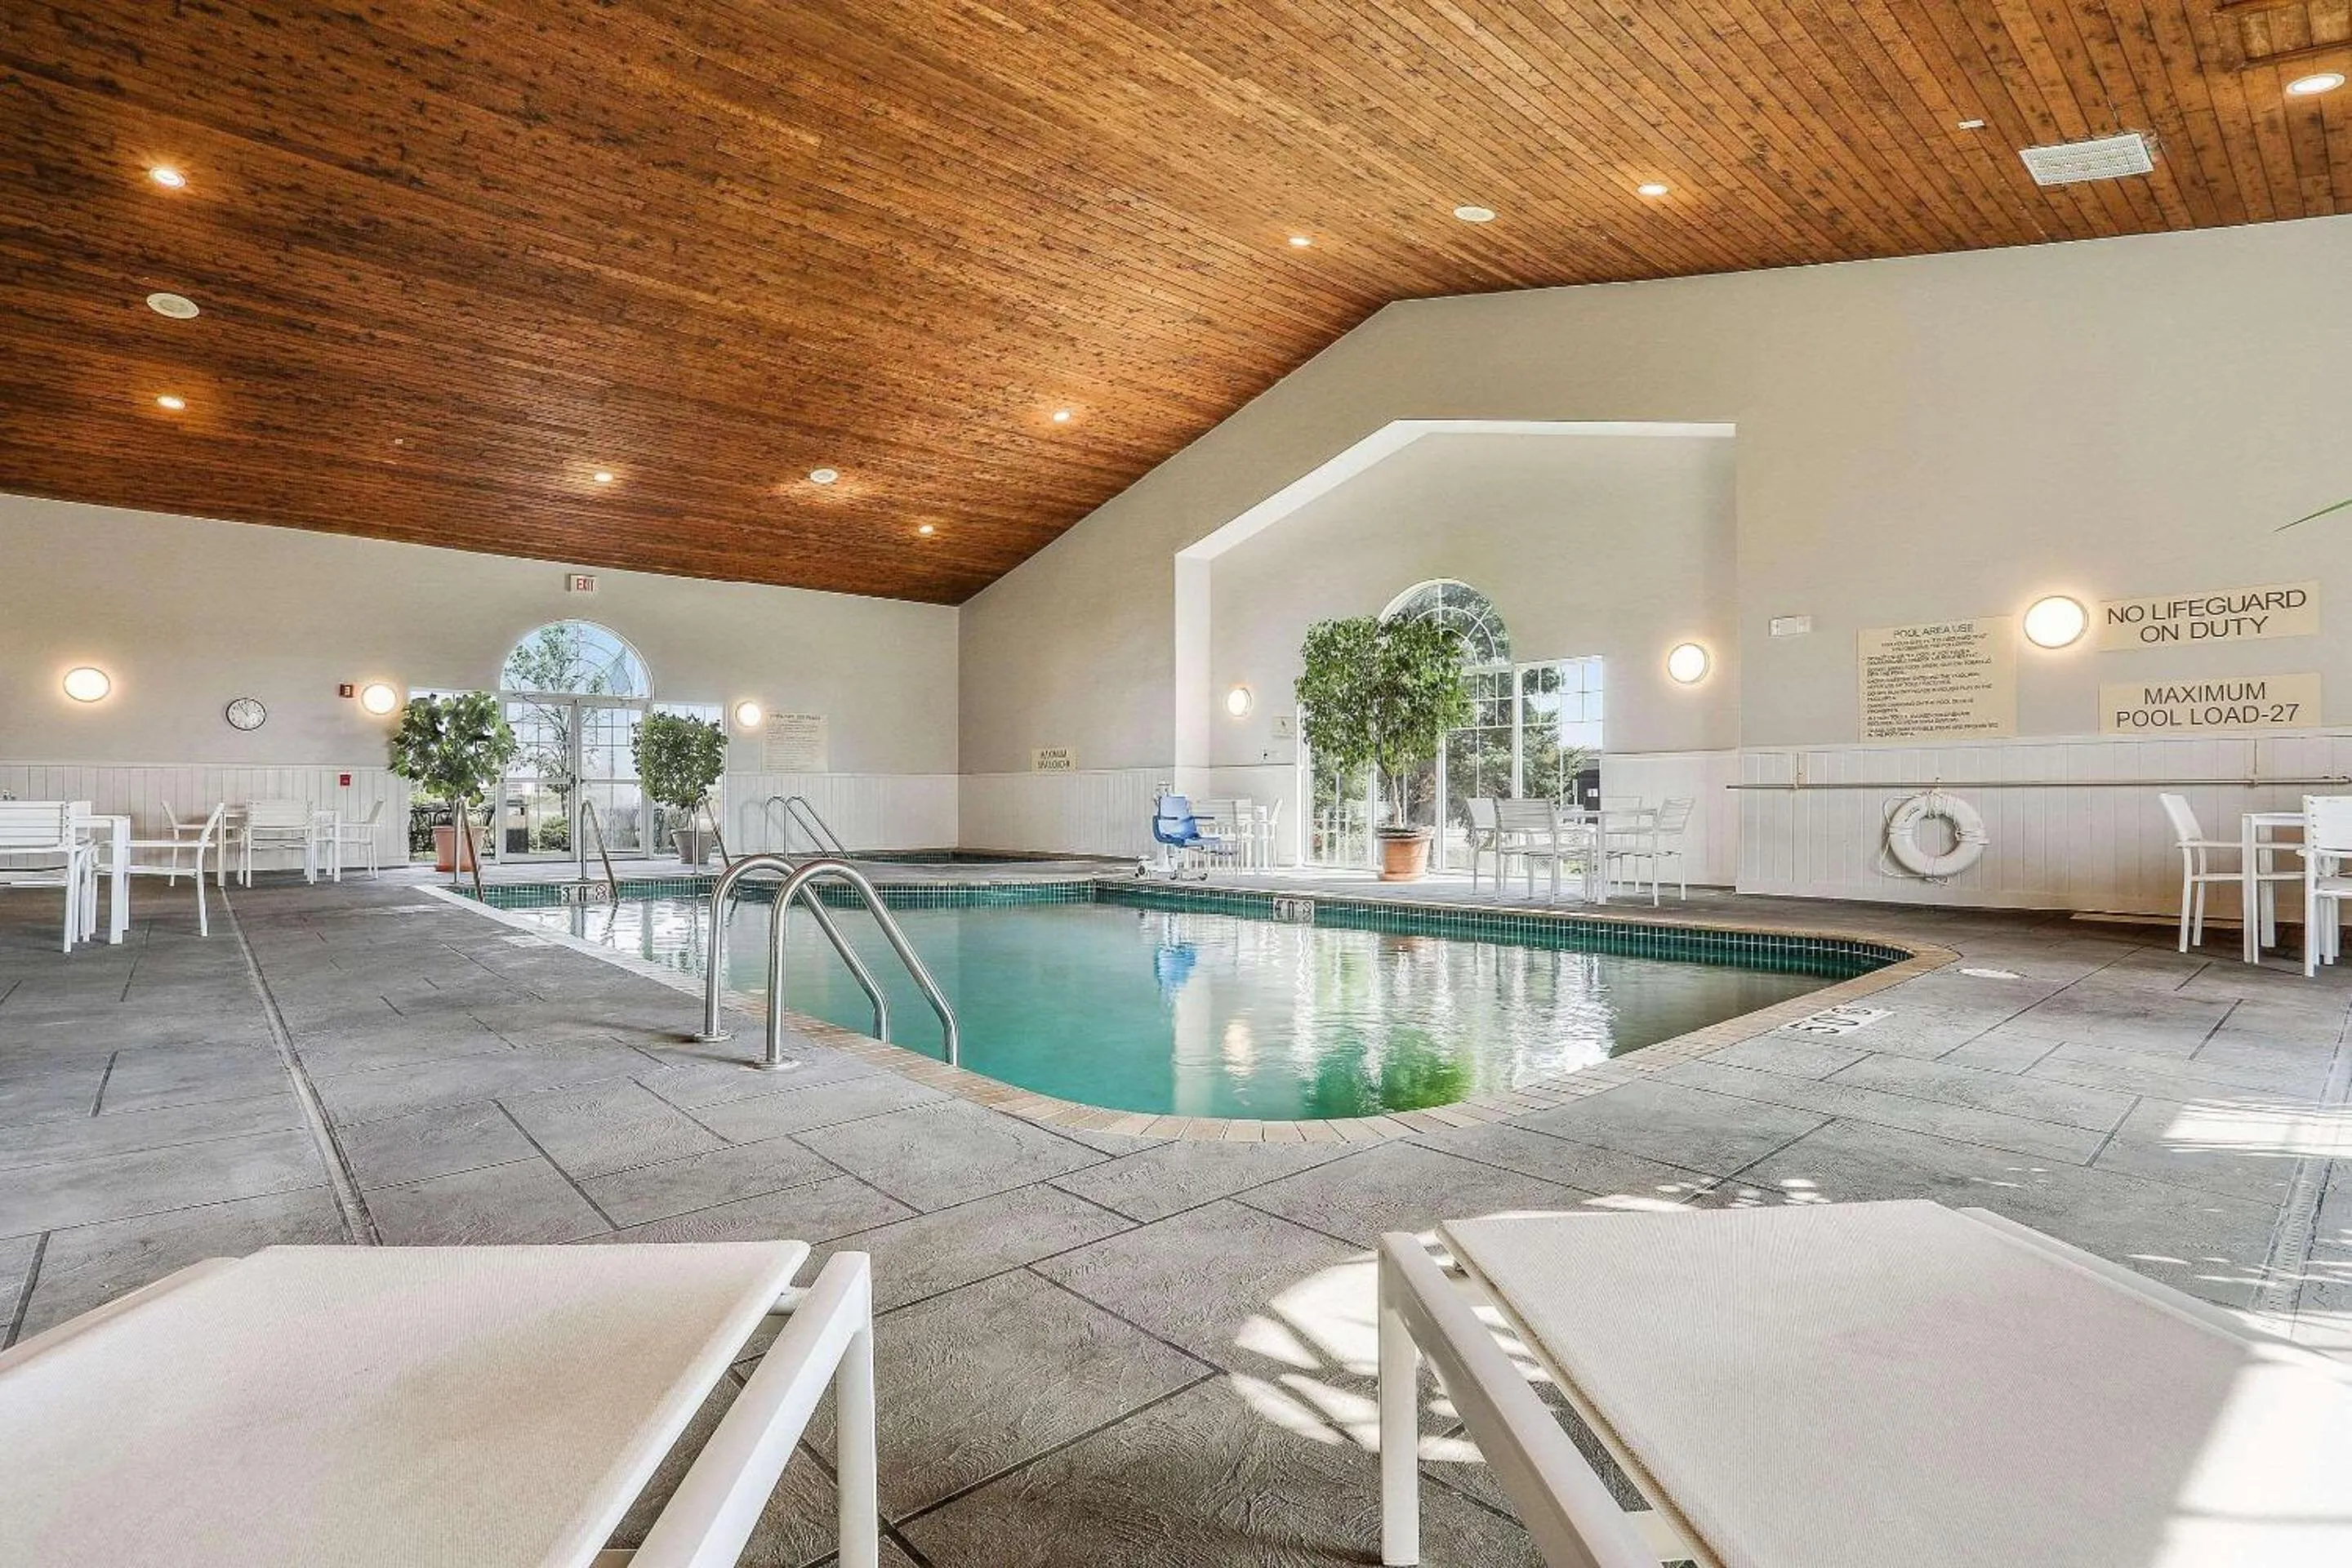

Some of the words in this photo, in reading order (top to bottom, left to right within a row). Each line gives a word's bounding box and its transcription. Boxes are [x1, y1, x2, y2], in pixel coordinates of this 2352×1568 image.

[577, 578, 595, 591] EXIT
[2108, 605, 2145, 624] NO
[2152, 589, 2306, 621] LIFEGUARD
[1893, 629, 1920, 638] POOL
[1952, 623, 1974, 633] USE
[2140, 624, 2179, 643] ON
[2190, 616, 2269, 639] DUTY
[2144, 682, 2266, 705] MAXIMUM
[2117, 709, 2181, 728] POOL
[2191, 703, 2300, 725] LOAD-27
